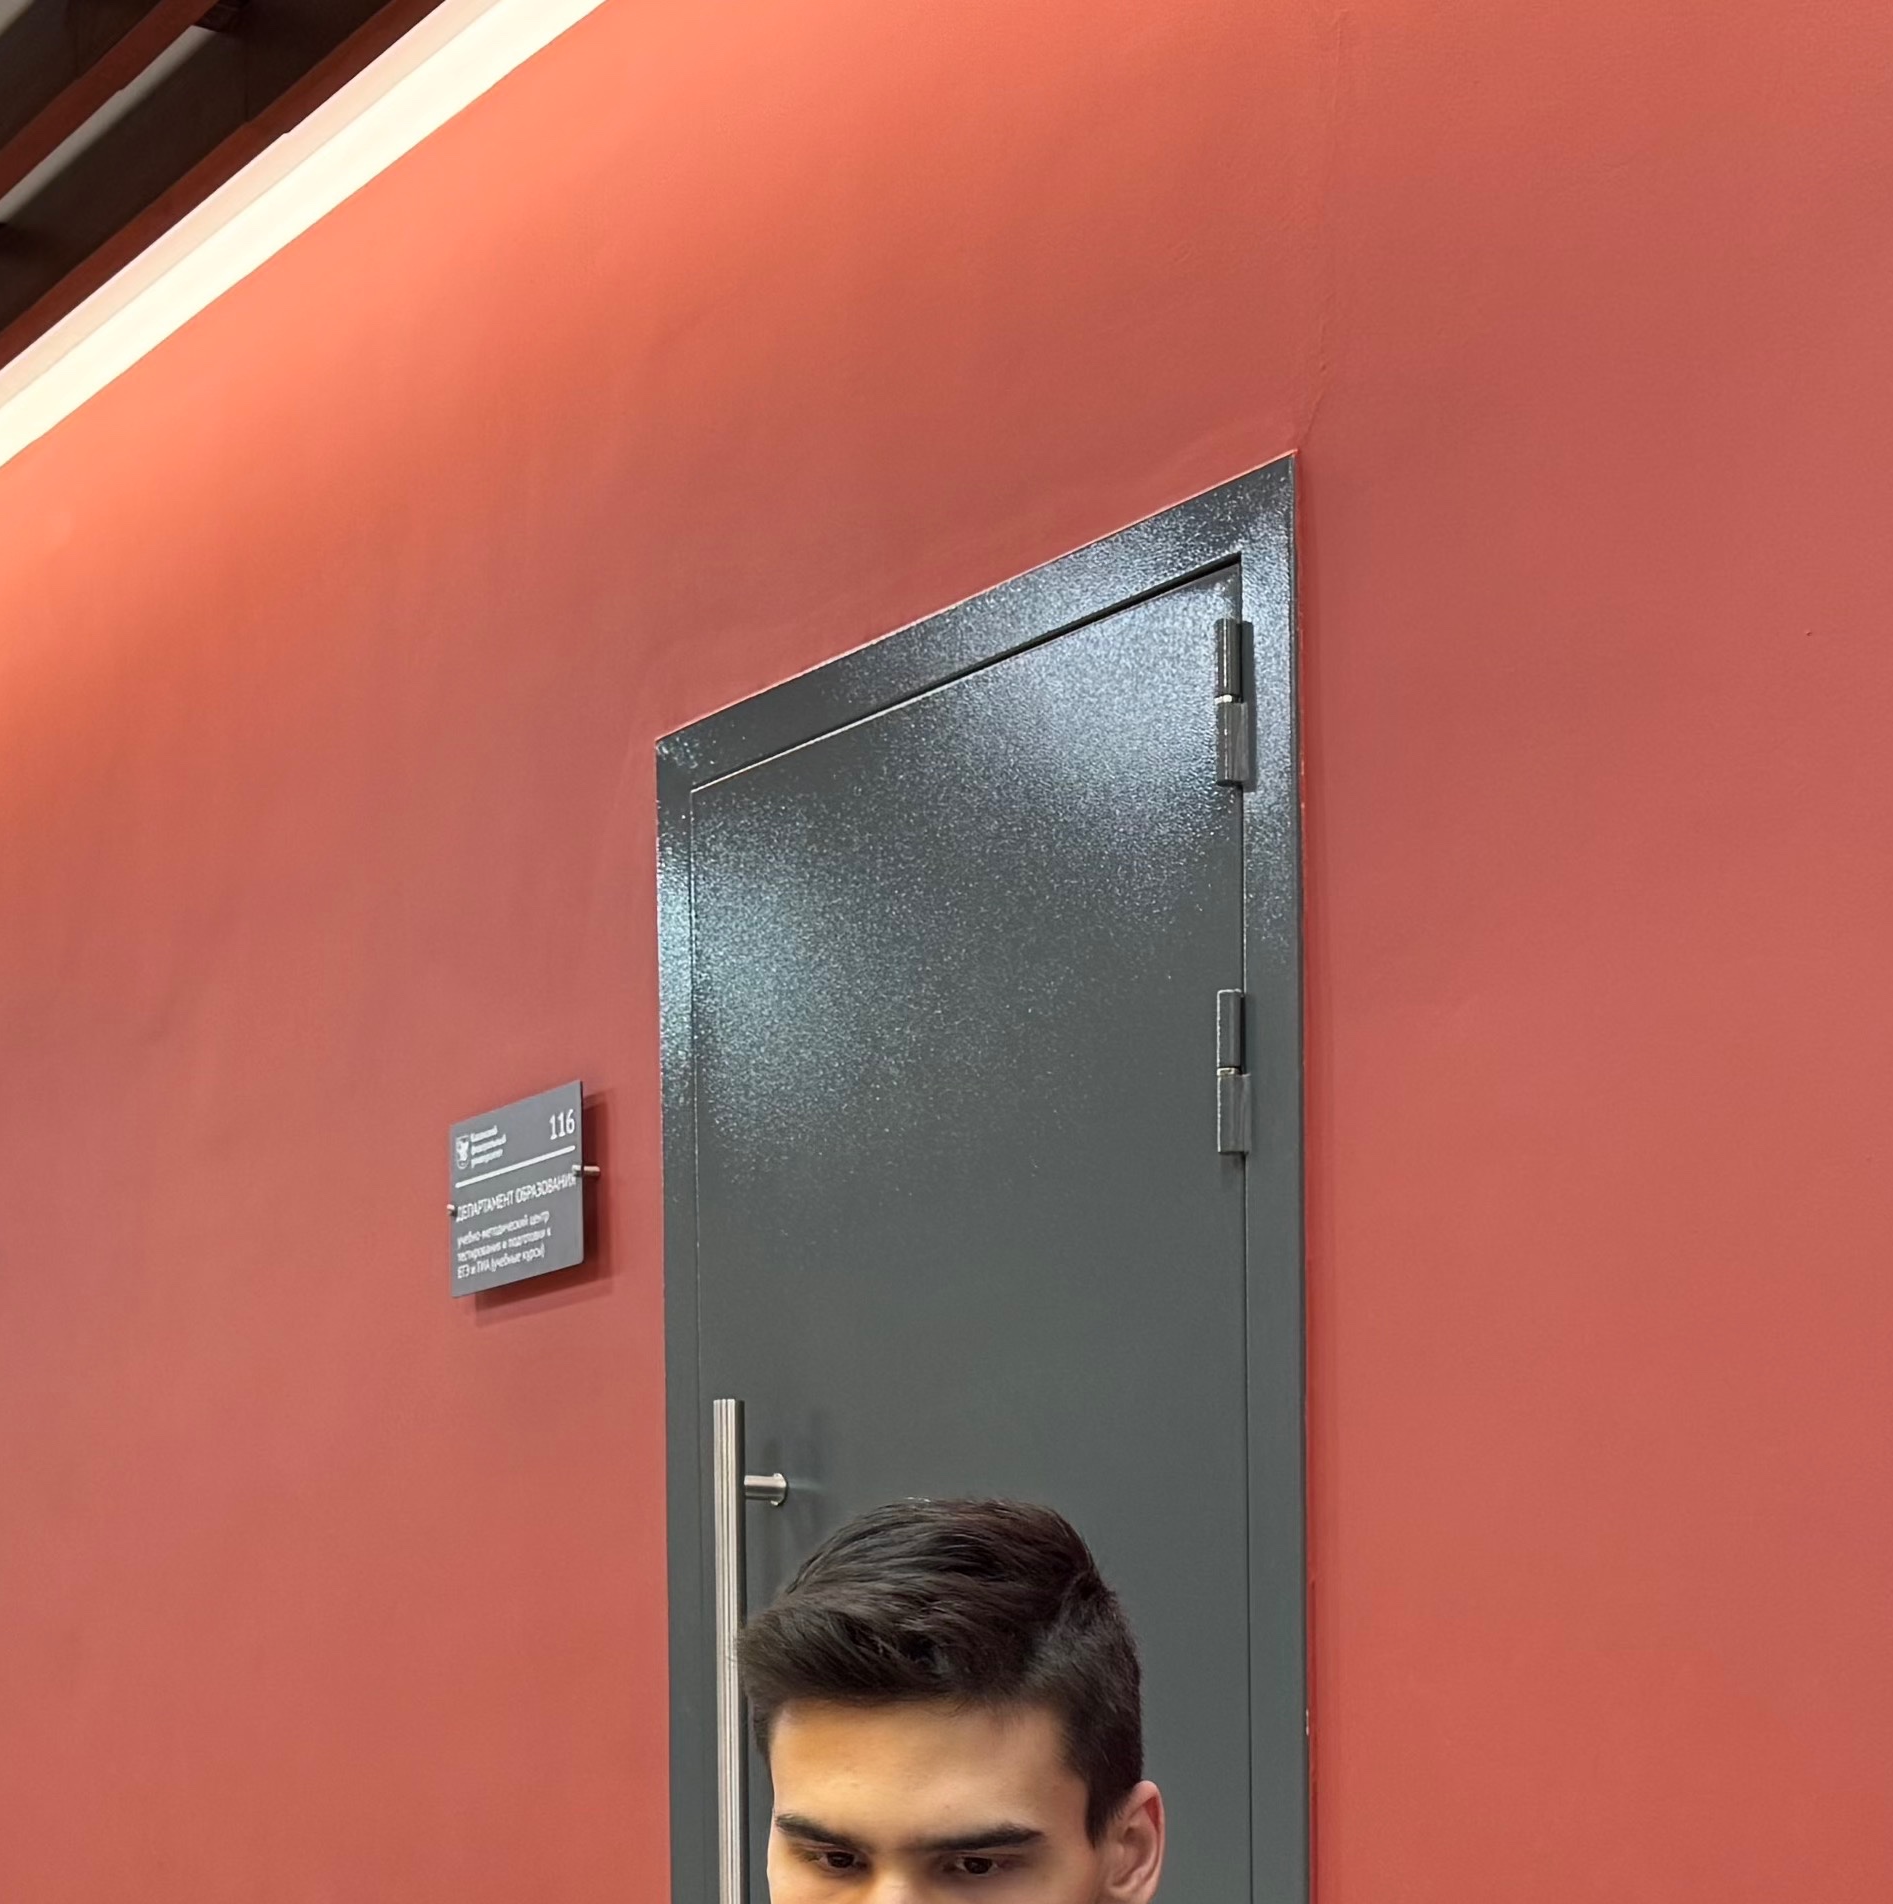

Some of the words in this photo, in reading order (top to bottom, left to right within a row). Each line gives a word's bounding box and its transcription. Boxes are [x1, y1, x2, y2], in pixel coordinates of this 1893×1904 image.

[549, 1109, 576, 1140] 116
[455, 1190, 514, 1222] ДЕПАРТАМЕНТ
[515, 1172, 577, 1204] ОБРАЗОВАНИЯ
